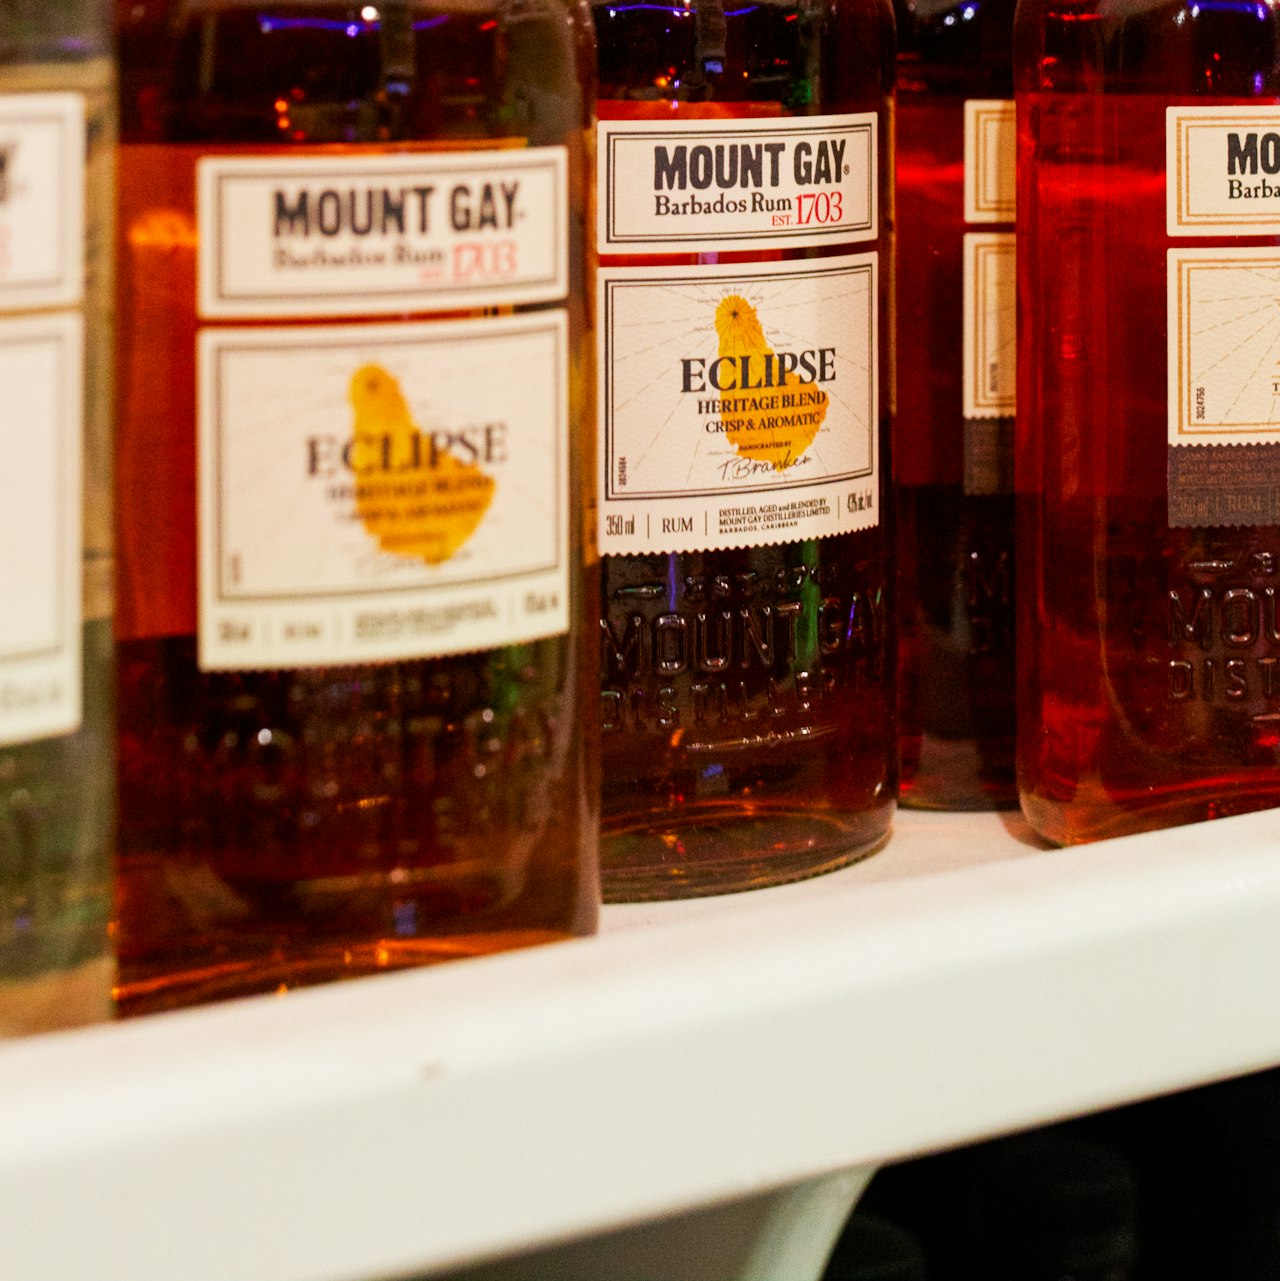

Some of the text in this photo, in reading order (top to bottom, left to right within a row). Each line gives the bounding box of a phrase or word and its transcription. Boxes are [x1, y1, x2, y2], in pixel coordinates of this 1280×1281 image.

[653, 142, 786, 191] MOUNT
[272, 185, 435, 238] MOUNT
[654, 191, 793, 217] Barbados Rum
[795, 191, 844, 225] 1703
[679, 347, 837, 394] ECLIPSE
[696, 390, 827, 415] HERITAGE BLEND
[705, 410, 822, 435] CRISP & AROMATIC
[304, 423, 510, 480] ECLIPSE
[738, 441, 781, 452] HANDCRAFTED
[719, 506, 831, 527] MOUNT GAY DISTILLERIES LIMITED
[758, 504, 777, 514] AGED
[790, 499, 819, 510] BLENDED
[661, 517, 694, 534] RUM
[599, 601, 802, 677] MOUNT
